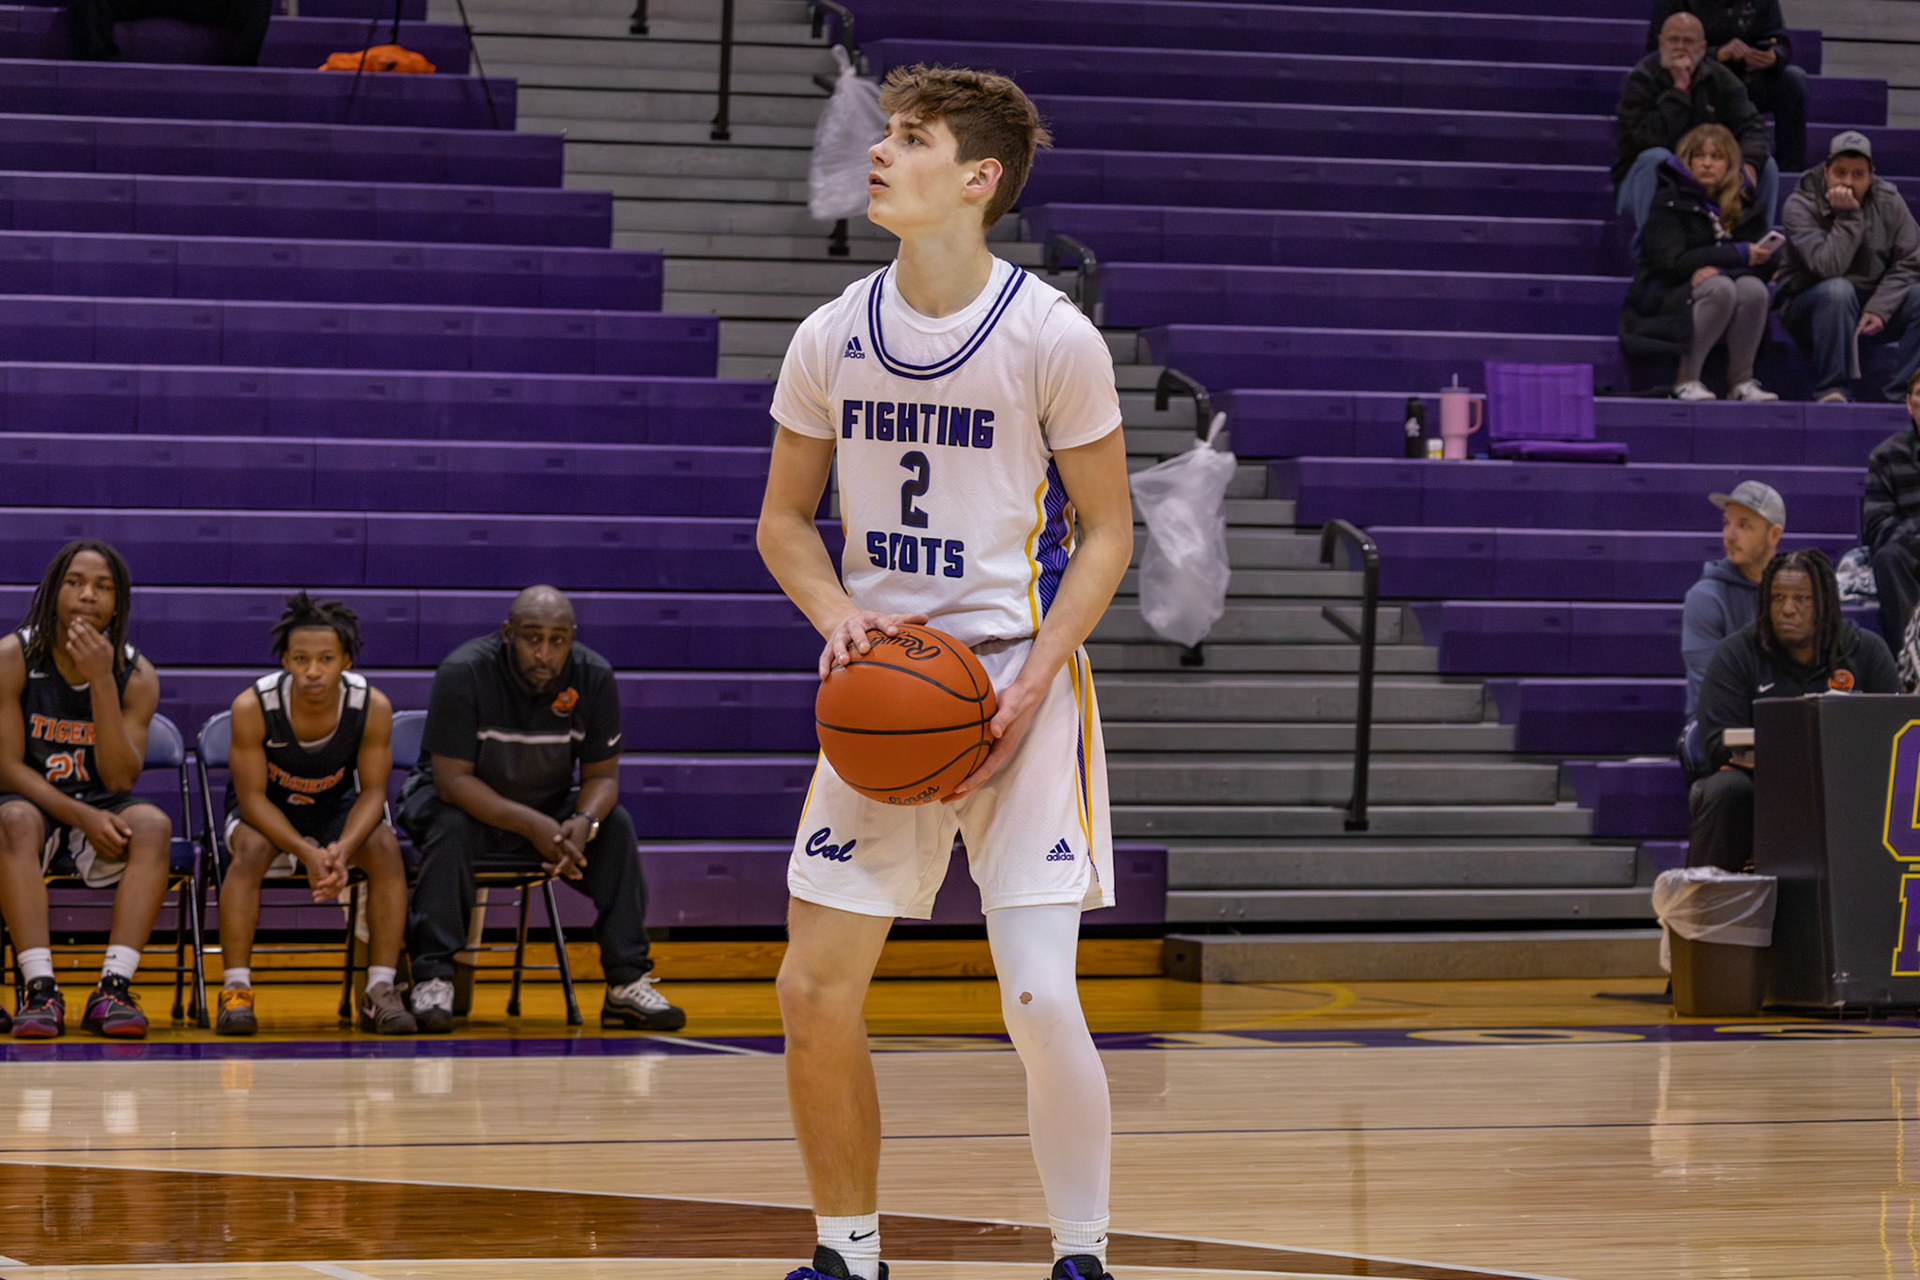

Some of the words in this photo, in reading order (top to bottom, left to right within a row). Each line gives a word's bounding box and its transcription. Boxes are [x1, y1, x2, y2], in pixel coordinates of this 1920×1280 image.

[842, 399, 995, 449] FIGHTING
[900, 450, 931, 529] 2
[30, 713, 97, 746] TIGER
[45, 748, 90, 782] 21
[266, 762, 346, 793] TIGERS
[805, 827, 857, 862] Cal
[1046, 852, 1075, 862] adidas
